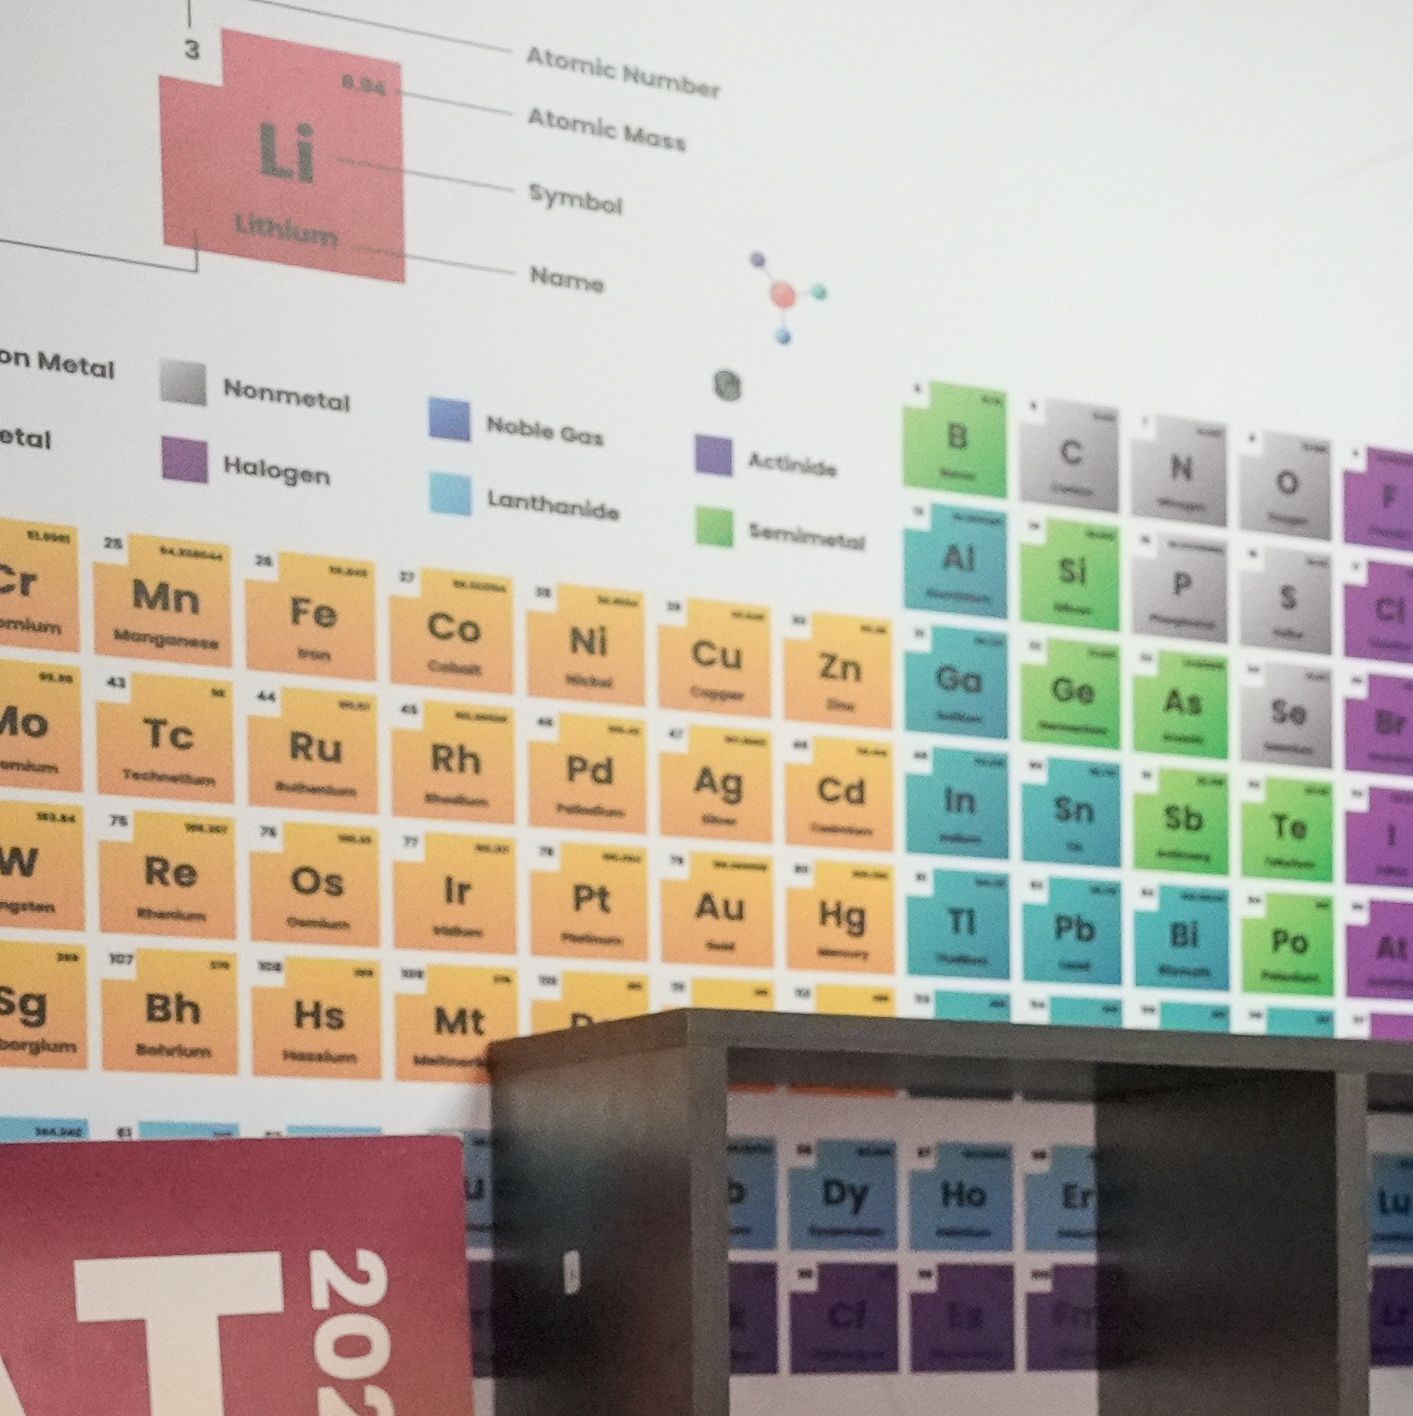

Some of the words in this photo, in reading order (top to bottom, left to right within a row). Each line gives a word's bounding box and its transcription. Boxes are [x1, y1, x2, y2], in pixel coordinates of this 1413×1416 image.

[184, 40, 200, 60] 3
[527, 46, 616, 80] Atomic
[623, 65, 721, 99] Number
[528, 107, 616, 139] Atomic
[624, 125, 687, 151] Mass
[260, 122, 314, 184] Li
[529, 183, 623, 216] Symbol
[235, 213, 339, 249] Lithium
[530, 265, 605, 294] Name
[38, 351, 116, 380] Metal
[224, 378, 351, 413] Nonmetal
[486, 416, 555, 442] Noble
[561, 426, 605, 448] Gas
[948, 422, 968, 449] B
[748, 451, 838, 479] Actinide
[1061, 439, 1083, 465] C
[1172, 453, 1193, 480] N
[224, 455, 331, 487] Halogen
[1276, 470, 1299, 495] O
[487, 490, 621, 523] Lanthanide
[748, 523, 866, 552] Semimetal
[943, 544, 975, 572] Al
[1058, 557, 1087, 585] Si
[132, 578, 199, 615] Mn
[1173, 570, 1193, 595] P
[1281, 584, 1296, 610] S
[291, 596, 338, 628] Fe
[113, 628, 219, 650] Manganese
[427, 612, 481, 642] Co
[570, 625, 607, 656] Ni
[691, 640, 742, 669] Cu
[819, 652, 862, 682] Zn
[936, 664, 983, 694] Ga
[1052, 676, 1096, 704] Ge
[1163, 688, 1203, 715] As
[1271, 699, 1308, 726] Se
[143, 718, 194, 751] Tc
[290, 731, 342, 763] Ru
[431, 743, 482, 775] Rh
[567, 754, 613, 785] Pd
[694, 766, 743, 805] Ag
[818, 776, 865, 805] Cd
[944, 785, 977, 815] In
[1054, 796, 1095, 823] Sn
[1163, 804, 1204, 831] Sb
[1271, 812, 1308, 840] Te
[145, 856, 198, 888] Re
[291, 866, 345, 897] Os
[445, 876, 471, 905] Ir
[573, 884, 611, 913] Pt
[695, 892, 744, 921] Au
[819, 900, 865, 937] Hg
[947, 907, 976, 935] Tl
[1055, 914, 1096, 942] Pb
[1170, 921, 1199, 948] Bi
[1271, 928, 1309, 955] Po
[145, 992, 201, 1024] Bh
[294, 1000, 345, 1030] Hs
[434, 1006, 486, 1035] Mt
[822, 1178, 870, 1215] Dy
[941, 1180, 987, 1207] Ho
